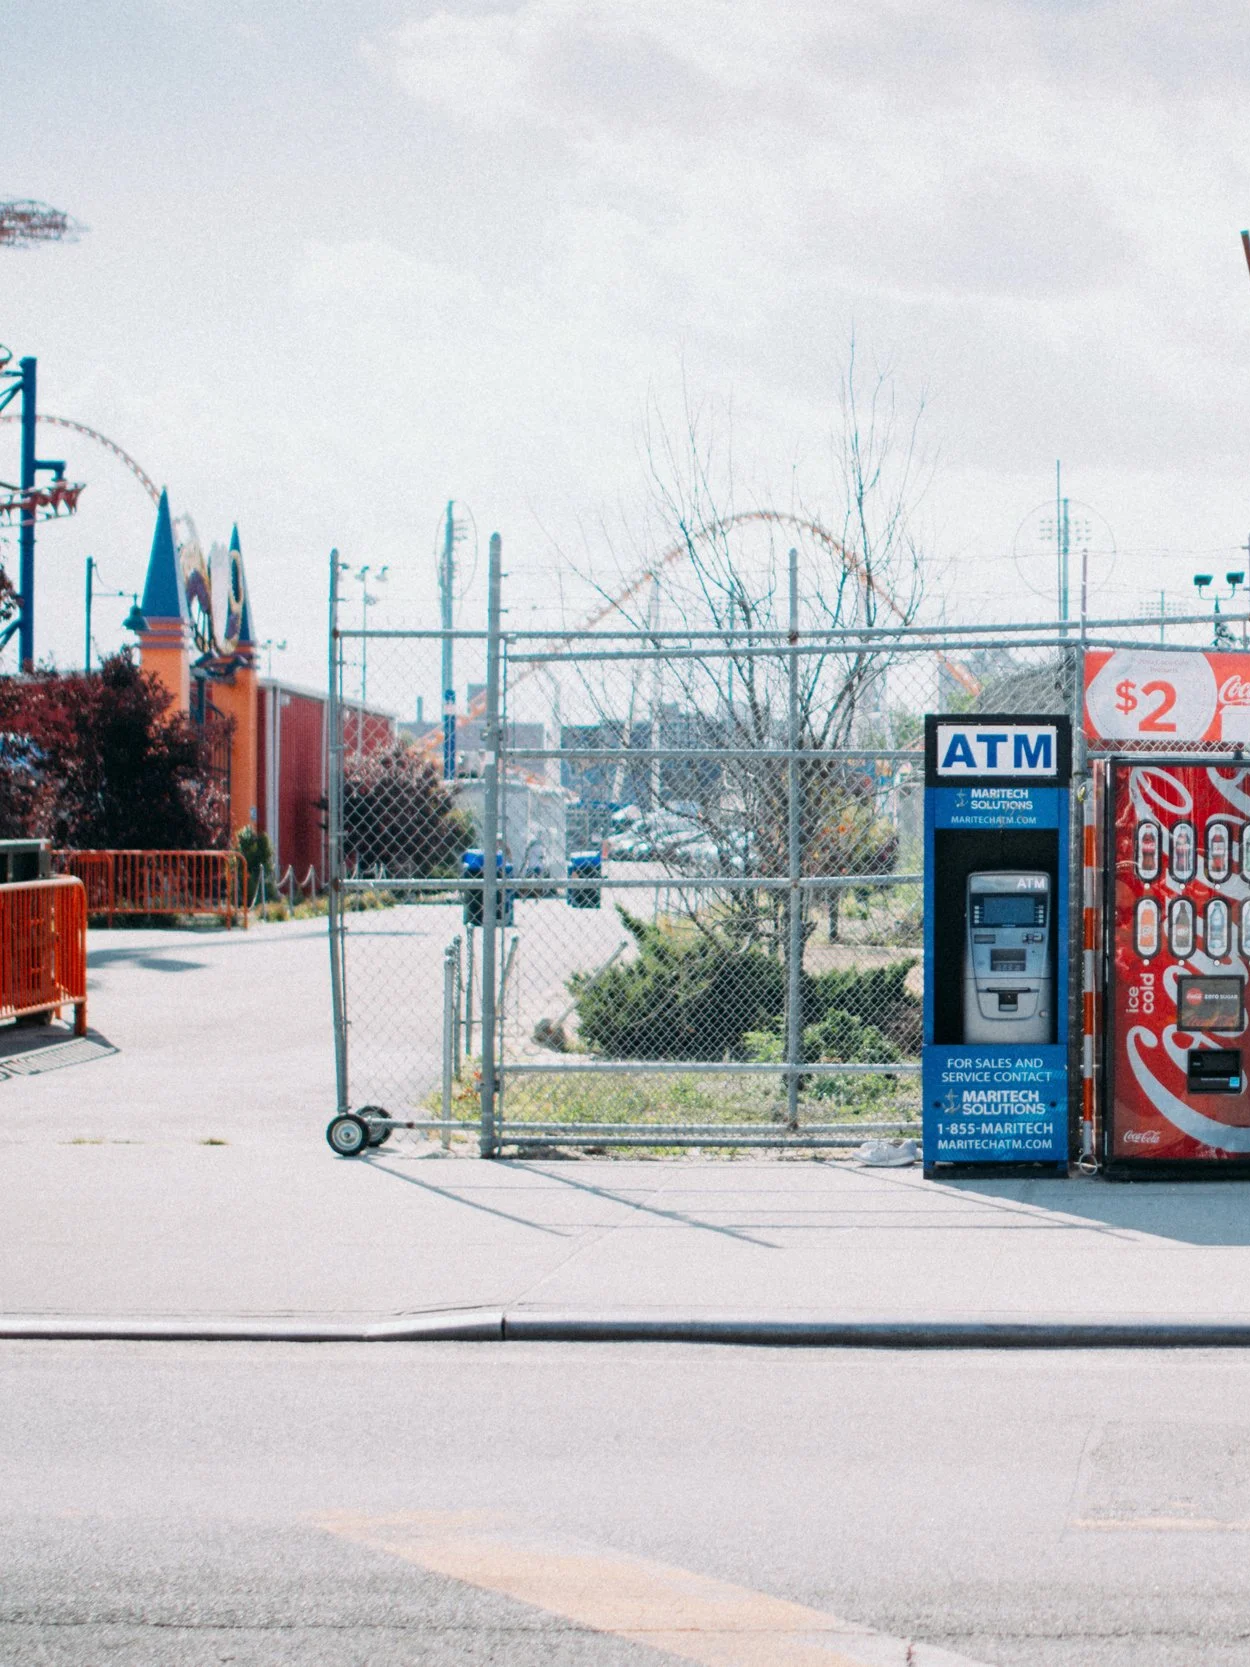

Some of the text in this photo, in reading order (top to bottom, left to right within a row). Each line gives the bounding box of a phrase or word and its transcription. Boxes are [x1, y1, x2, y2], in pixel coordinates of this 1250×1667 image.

[1115, 678, 1177, 732] $2
[941, 733, 1052, 769] ATM
[971, 788, 1029, 799] MARITECH
[971, 800, 1033, 810] SOLUTIONS
[951, 815, 1037, 824] MARITECHATM.COM
[1017, 877, 1045, 889] ATM
[1139, 972, 1155, 1014] cold
[1125, 986, 1140, 1013] ice
[947, 1058, 1044, 1069] FOR SALES AND
[941, 1072, 1052, 1082] SERVICE CONTACT
[962, 1090, 1039, 1103] MARITECH
[962, 1103, 1046, 1115] SOLUTIONS
[937, 1122, 1053, 1135] 1-855-MARITECH
[938, 1139, 1053, 1150] MARITECHATM.COM
